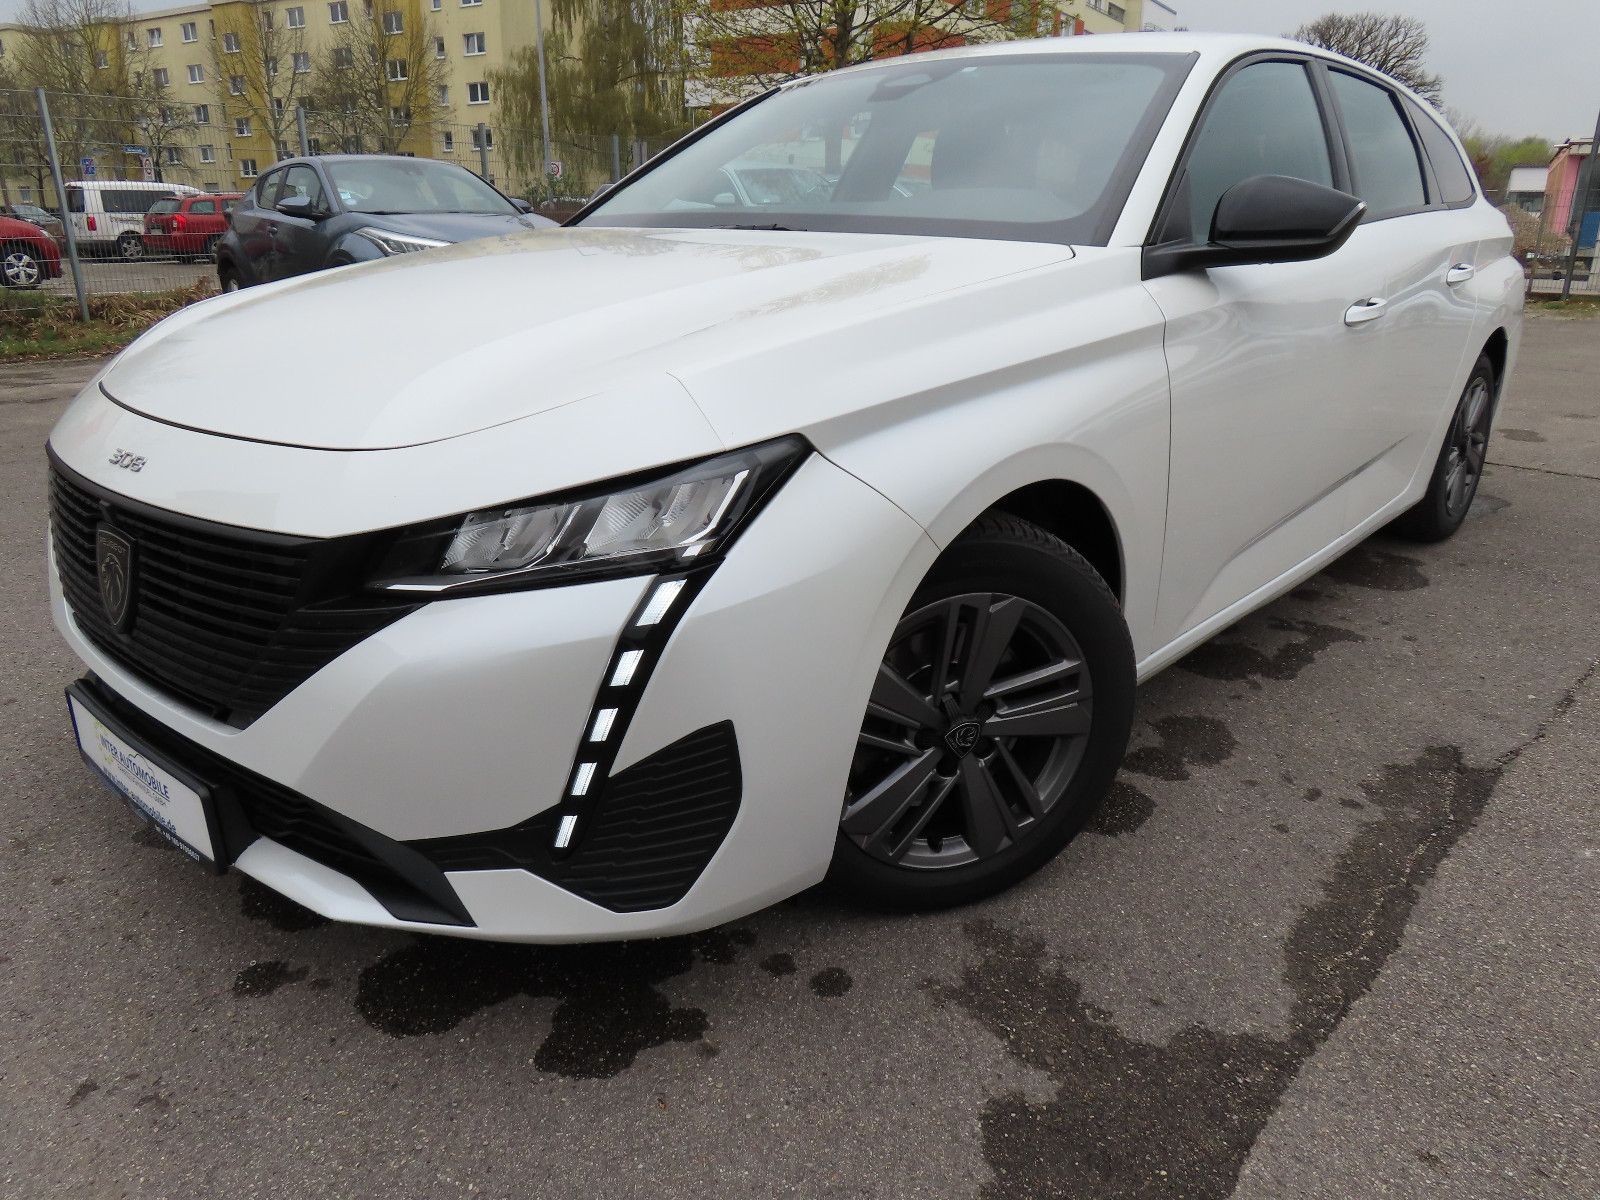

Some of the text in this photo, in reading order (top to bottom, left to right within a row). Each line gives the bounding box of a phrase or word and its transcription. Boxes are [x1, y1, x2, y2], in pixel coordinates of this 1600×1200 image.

[108, 448, 147, 473] 308
[100, 735, 119, 759] INTER
[119, 751, 170, 800] AUTOMOBILE
